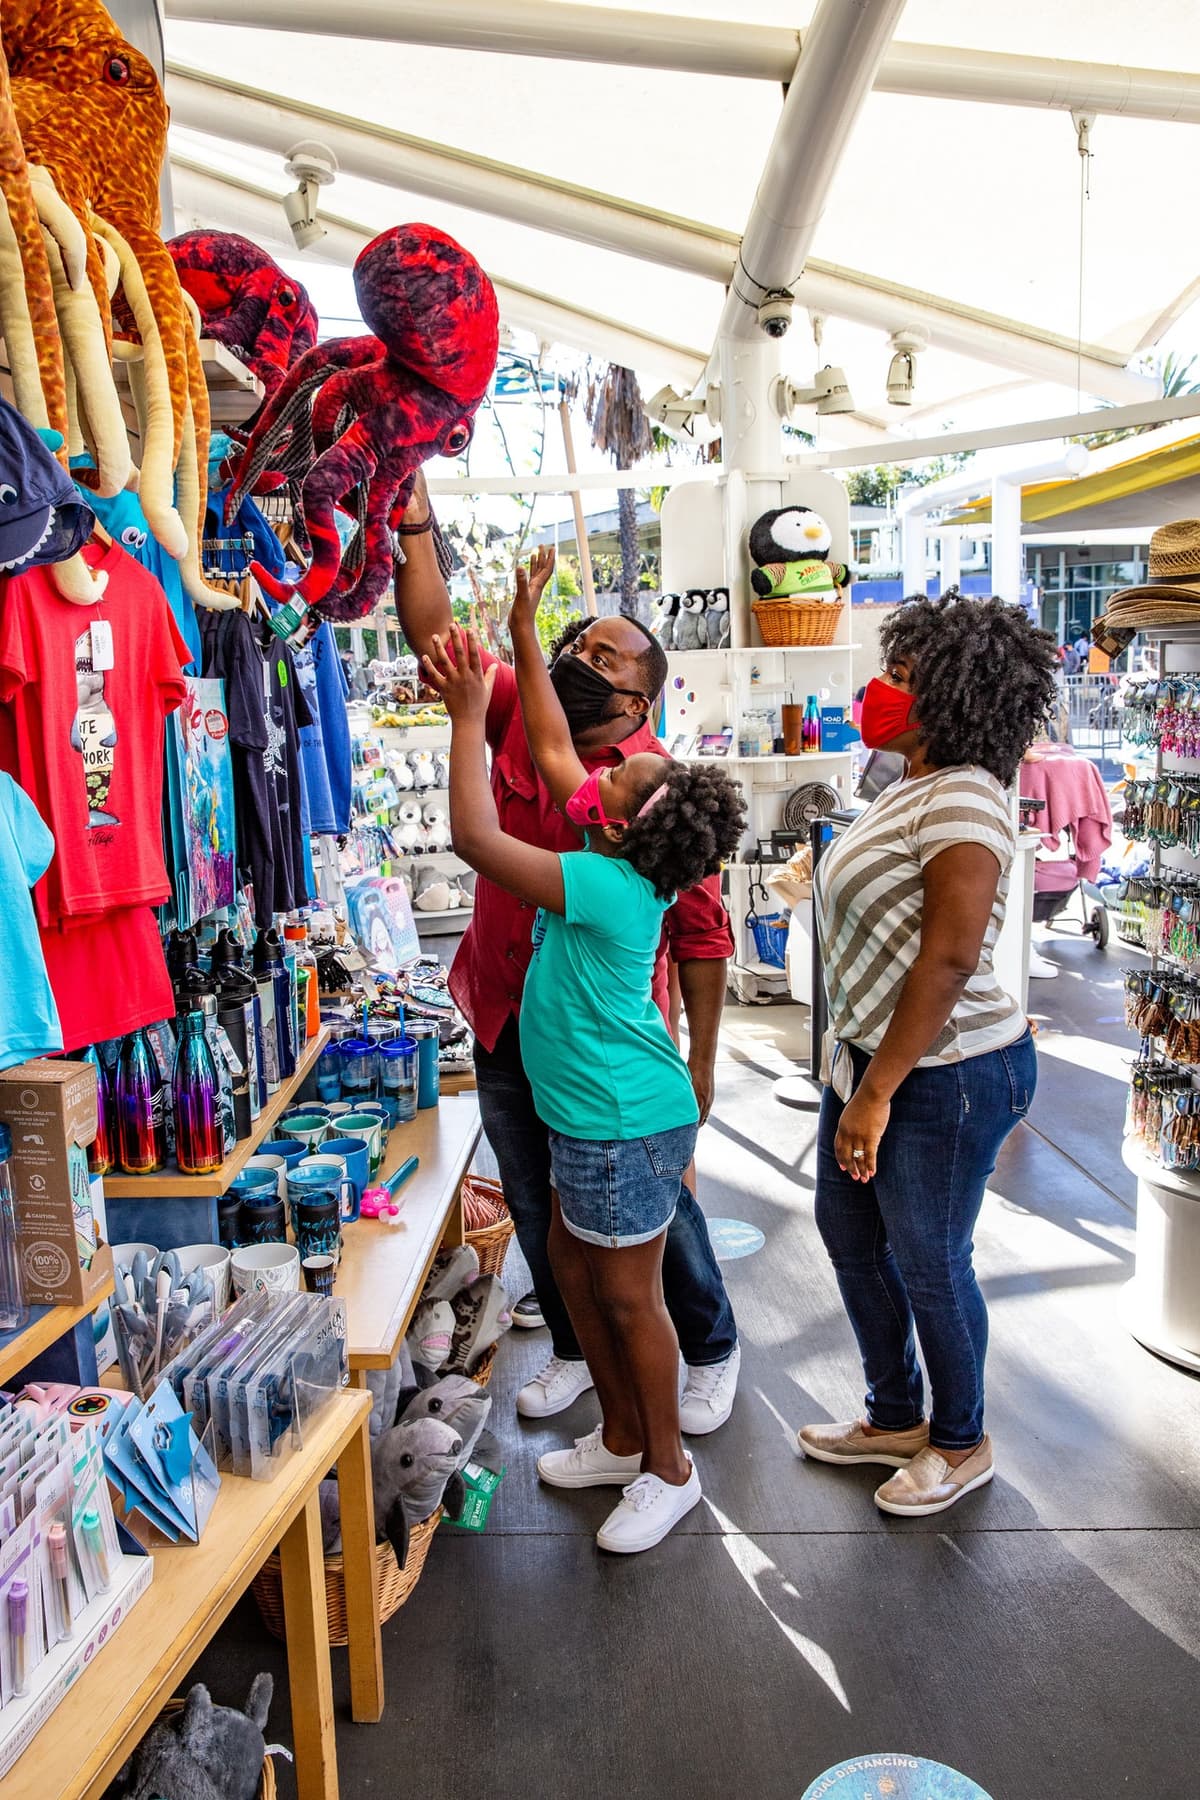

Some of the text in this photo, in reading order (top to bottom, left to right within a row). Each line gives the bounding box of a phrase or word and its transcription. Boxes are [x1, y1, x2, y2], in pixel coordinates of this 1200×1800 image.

[34, 1254, 60, 1266] 100%
[809, 1758, 919, 1800] CIAL DISTANCING
